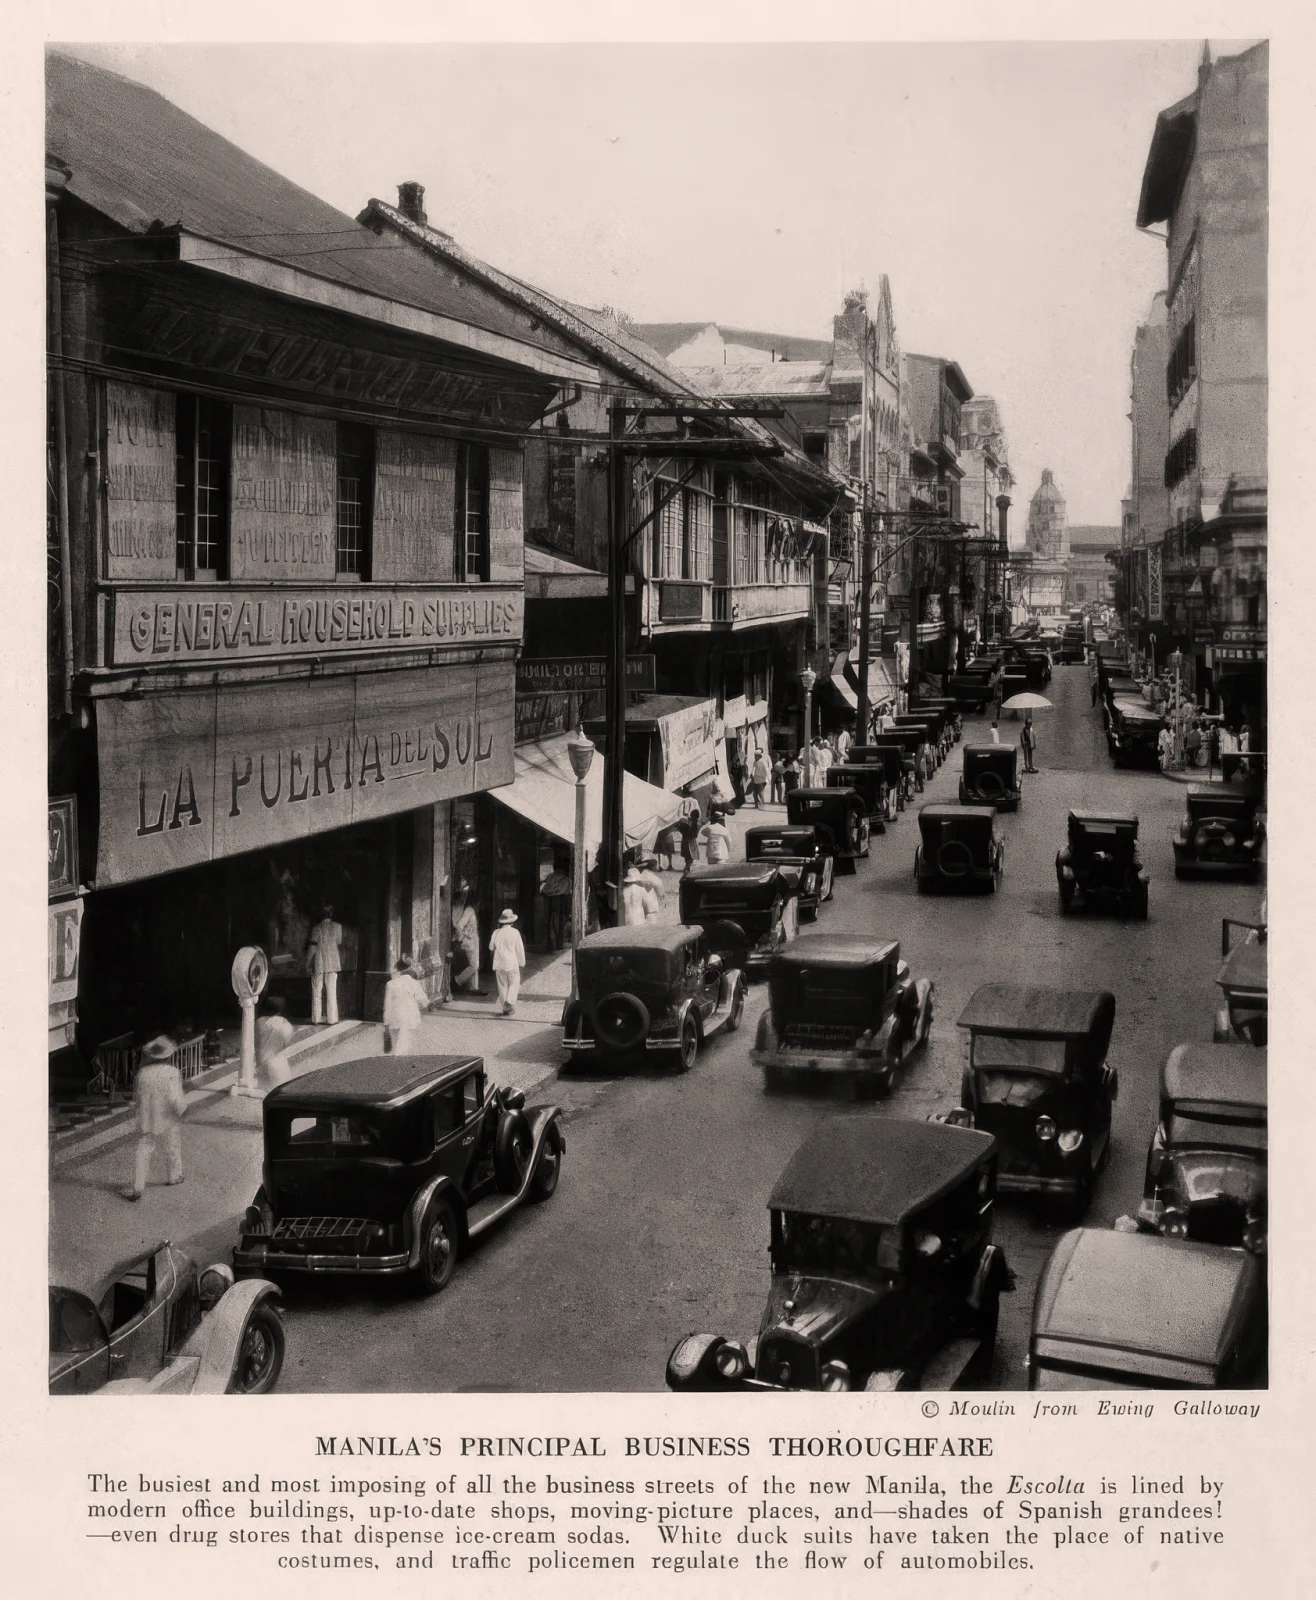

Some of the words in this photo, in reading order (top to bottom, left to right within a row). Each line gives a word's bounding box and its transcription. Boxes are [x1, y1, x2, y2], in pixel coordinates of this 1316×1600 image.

[130, 600, 275, 654] GENERAL
[281, 599, 415, 645] HOUSEHOLD
[420, 599, 515, 638] SUPPLIES
[136, 764, 202, 836] LA
[228, 735, 386, 817] PUERTA
[390, 728, 429, 766] DEL
